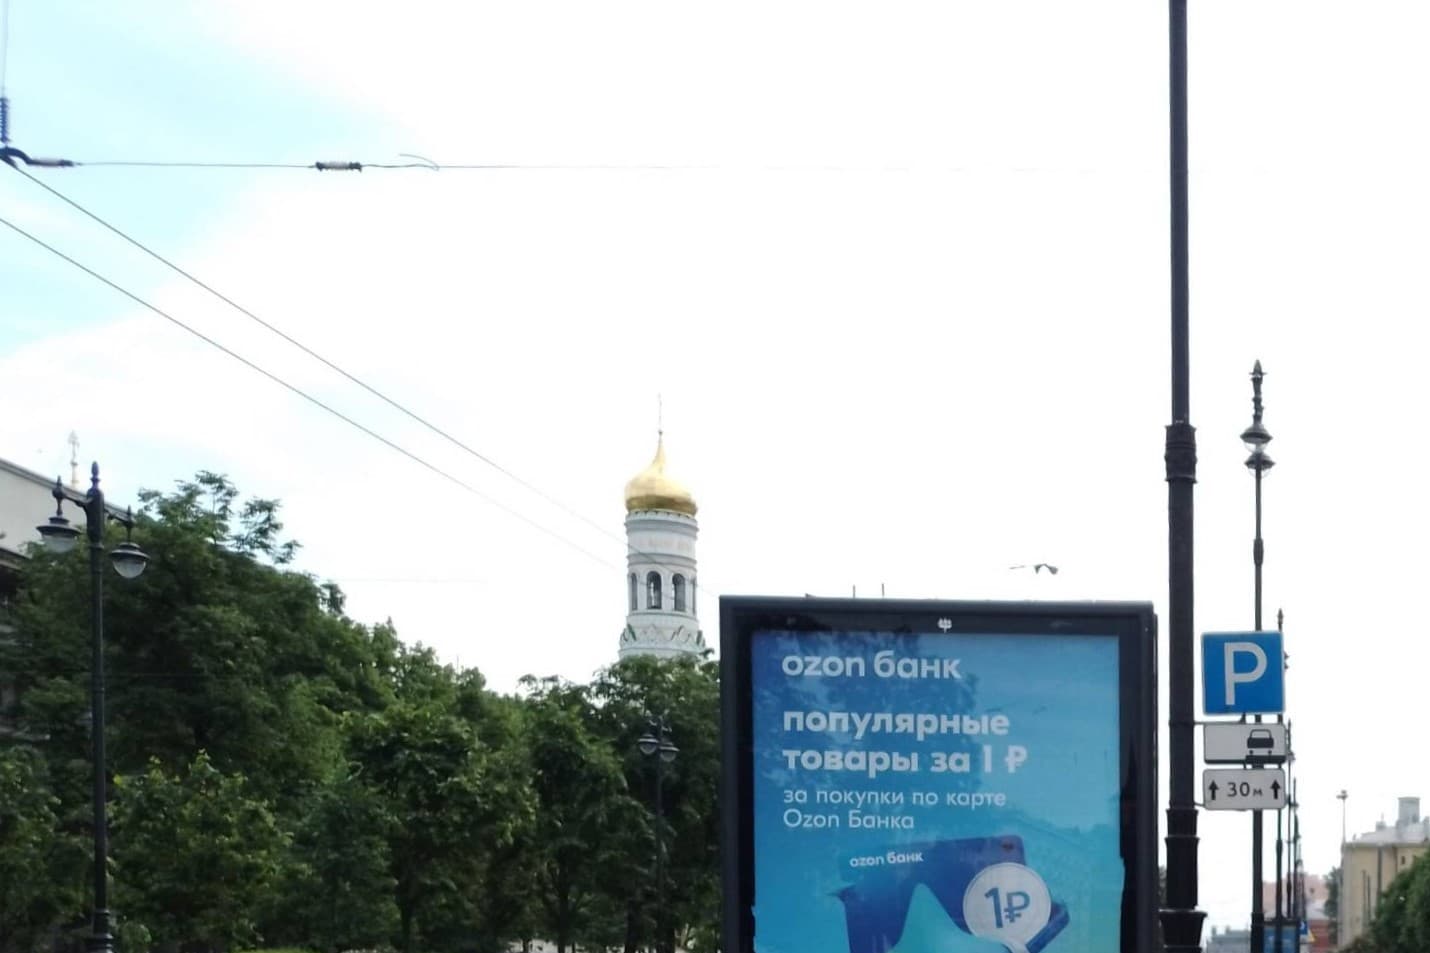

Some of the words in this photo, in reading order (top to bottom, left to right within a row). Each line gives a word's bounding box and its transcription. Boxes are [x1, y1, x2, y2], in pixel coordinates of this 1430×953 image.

[781, 655, 866, 677] ozon
[873, 650, 962, 679] банк
[1223, 642, 1268, 706] P
[783, 711, 1010, 741] популярные
[782, 749, 919, 778] товары
[930, 752, 970, 773] за
[783, 790, 808, 804] за
[816, 790, 904, 809] покупки
[912, 791, 938, 806] по
[946, 791, 1007, 810] карте
[783, 808, 840, 828] Ozon
[848, 810, 915, 829] Банка
[849, 855, 885, 867] ozon
[886, 851, 924, 865] банк
